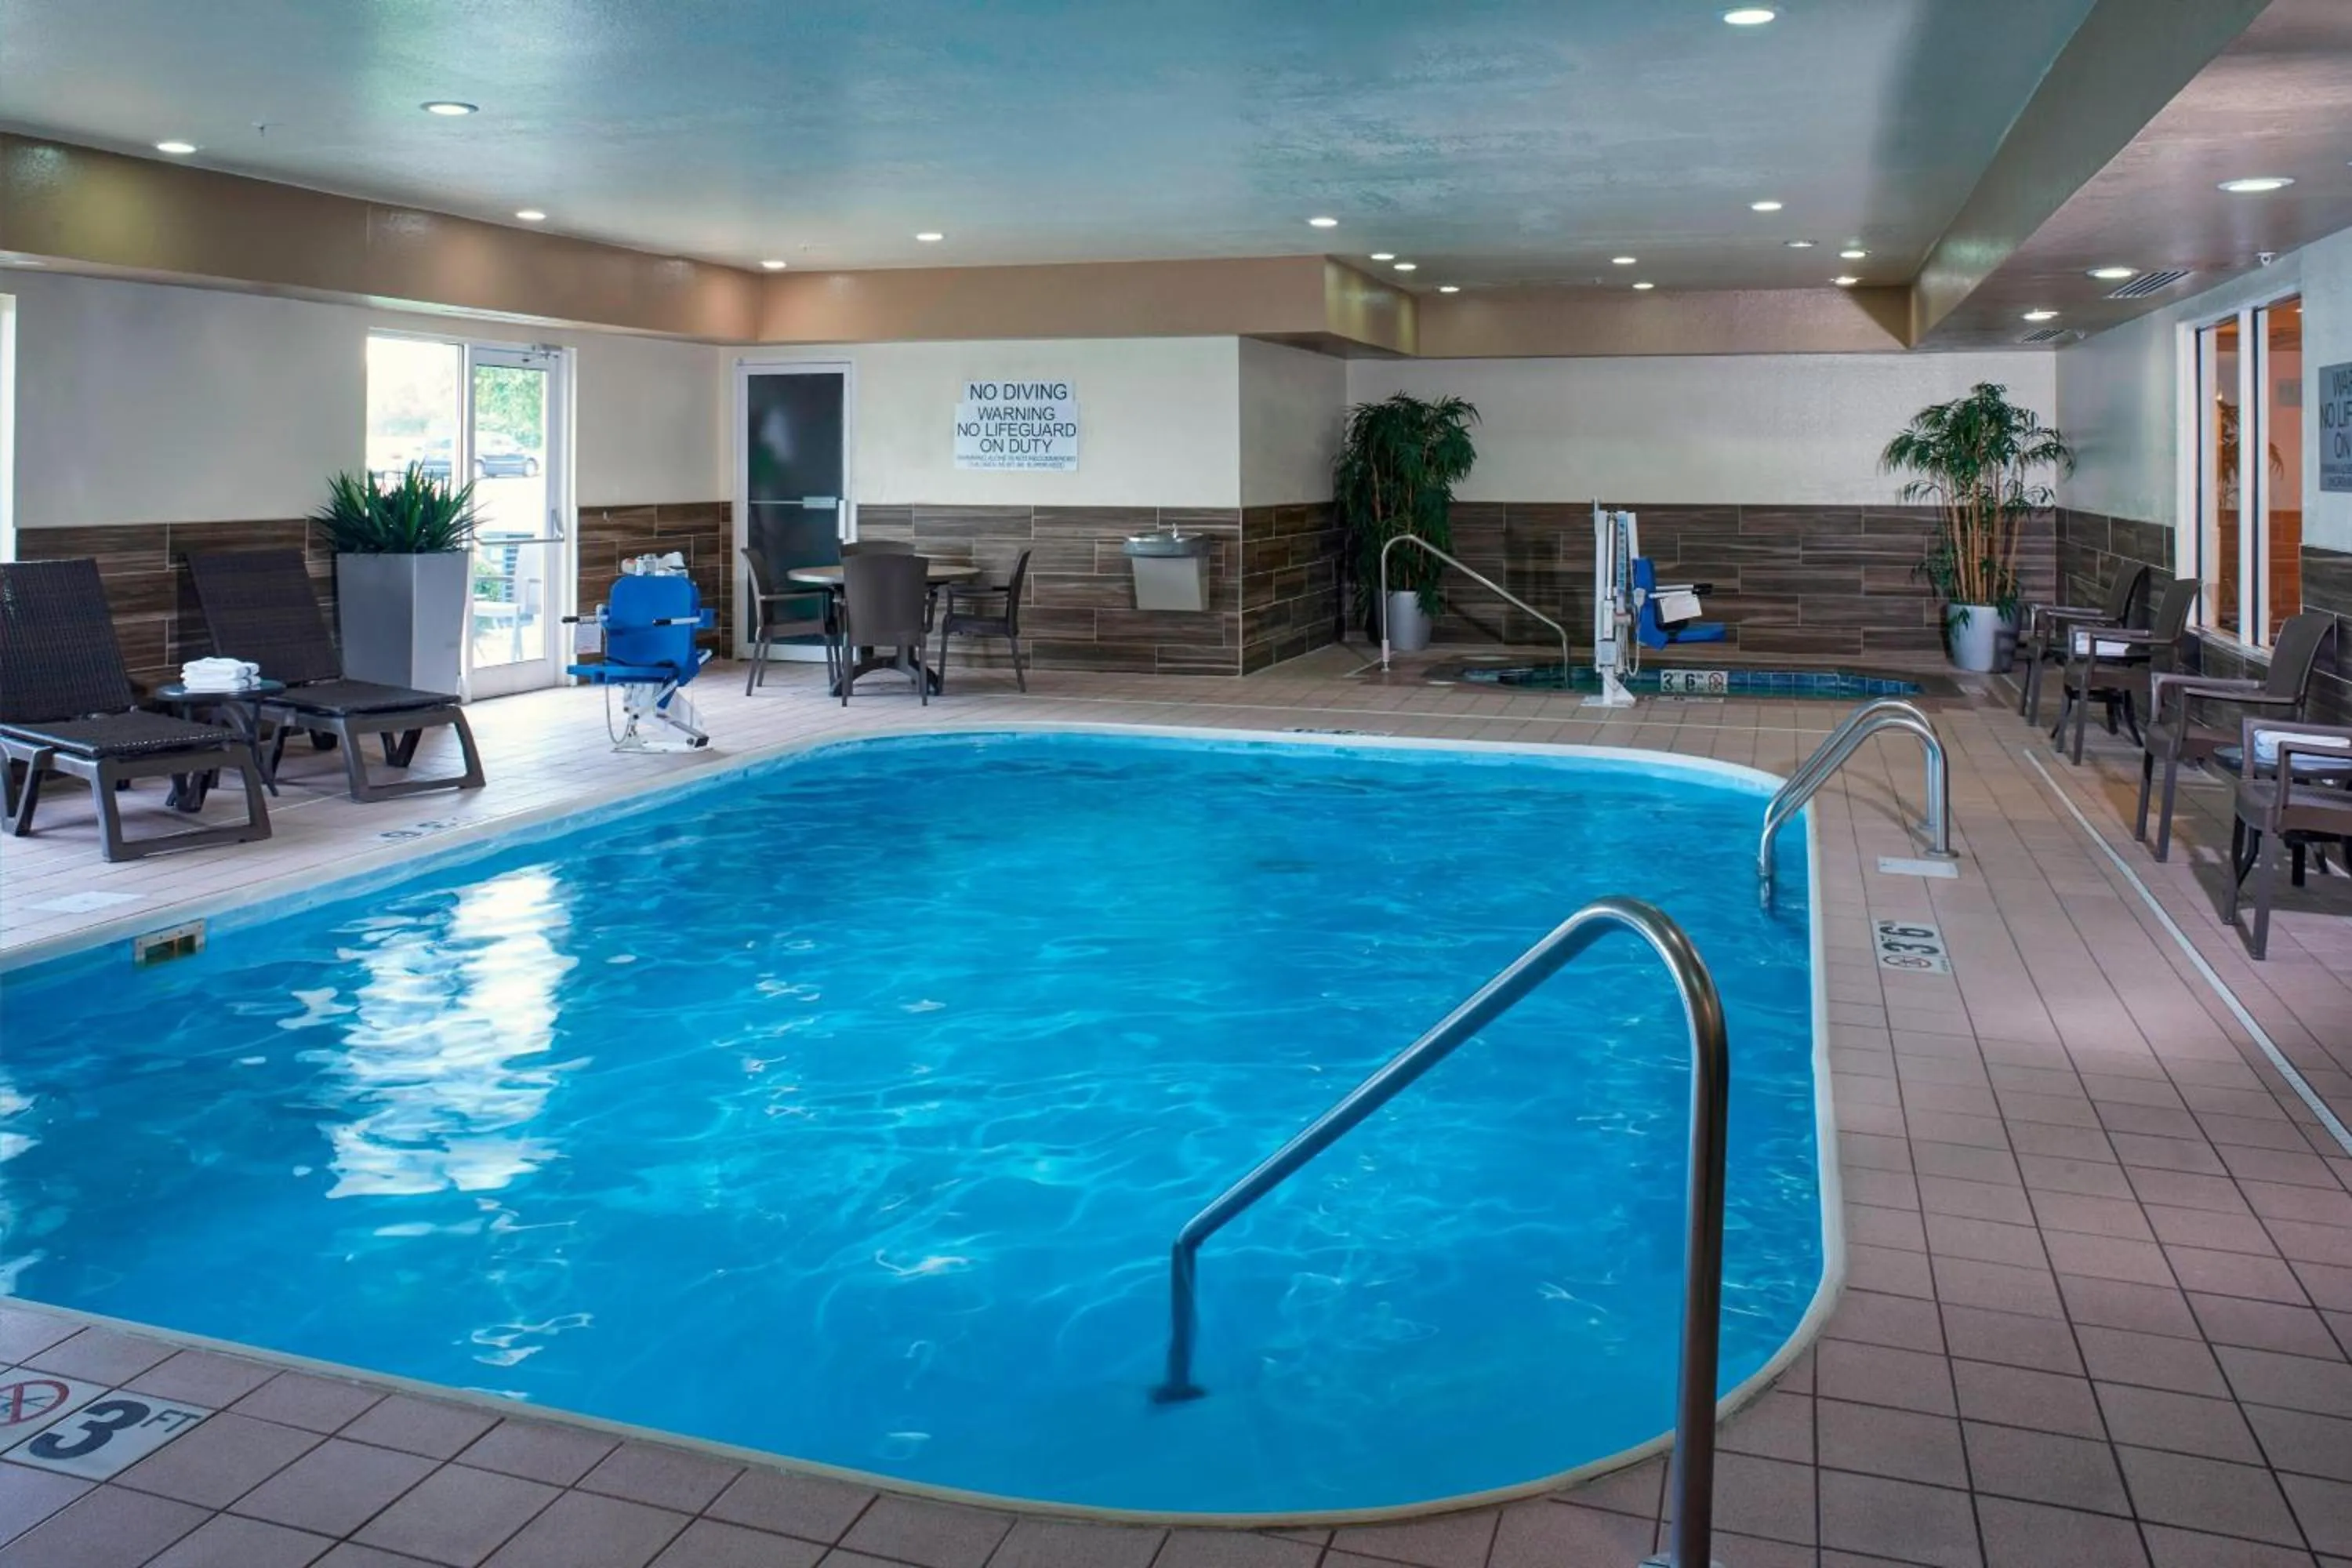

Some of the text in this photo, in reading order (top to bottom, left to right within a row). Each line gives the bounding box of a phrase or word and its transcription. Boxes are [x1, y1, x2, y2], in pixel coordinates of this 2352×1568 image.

[970, 383, 1067, 401] NO DIVING
[978, 406, 1055, 421] WARNING
[2320, 402, 2336, 430] NO
[957, 423, 1076, 437] NO LIFEGUARD
[980, 439, 1053, 453] ON DUTY
[1663, 673, 1673, 690] 3
[1685, 673, 1696, 691] 6
[28, 1399, 203, 1460] 3 FT
